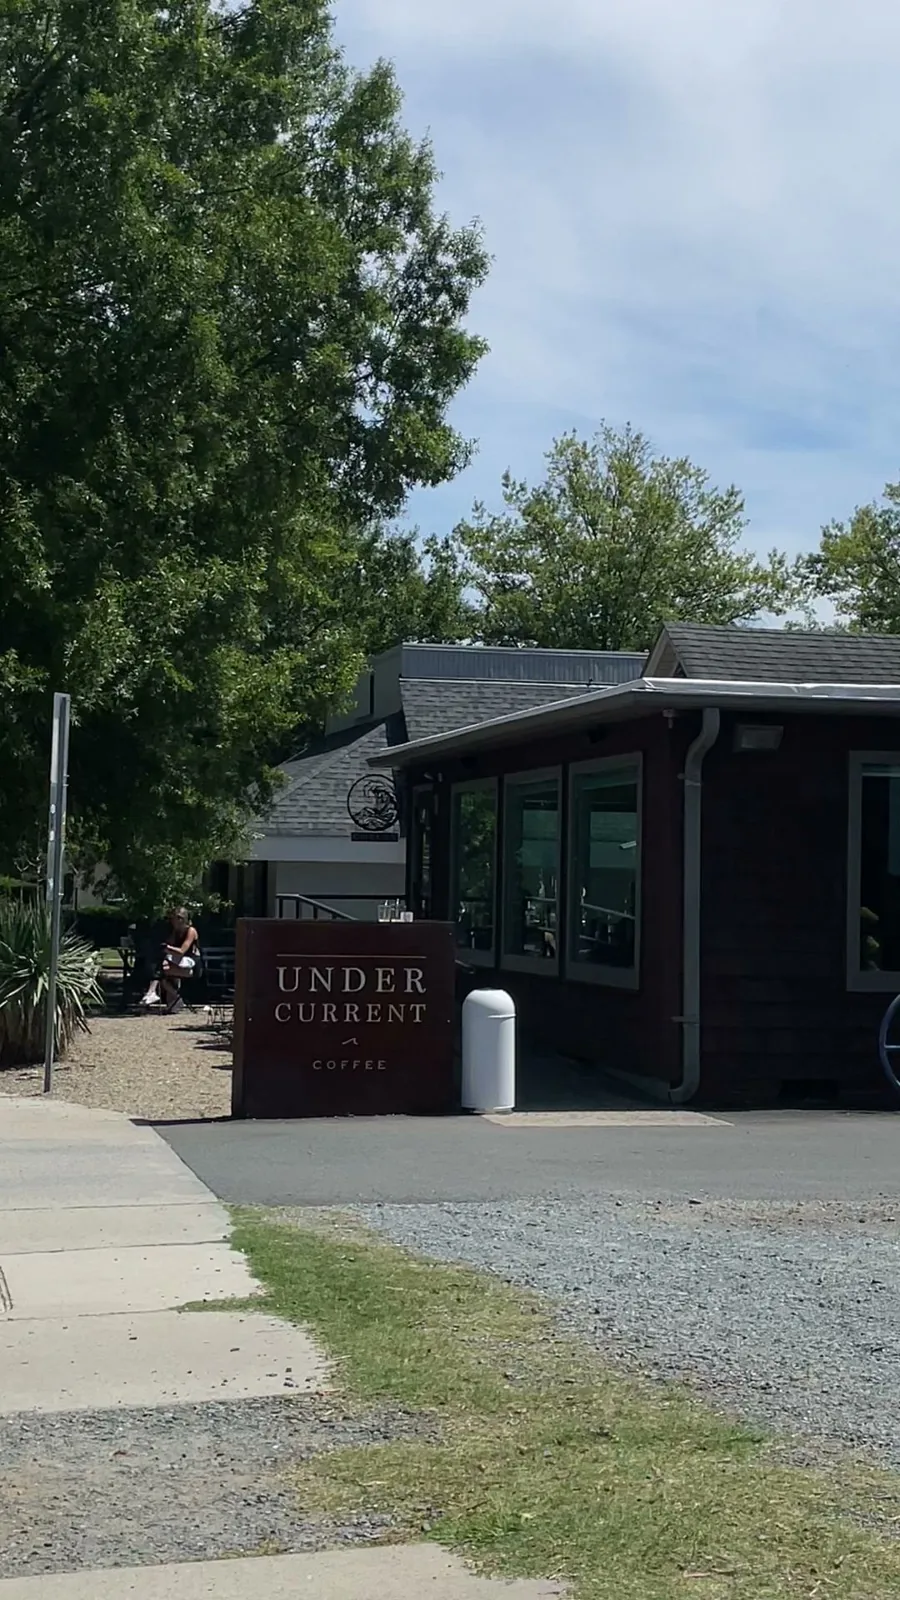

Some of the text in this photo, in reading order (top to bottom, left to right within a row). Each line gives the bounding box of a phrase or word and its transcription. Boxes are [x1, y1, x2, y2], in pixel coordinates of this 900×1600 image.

[276, 966, 427, 993] UNDER
[274, 1003, 427, 1023] CURRENT
[312, 1060, 387, 1070] COFFEE
